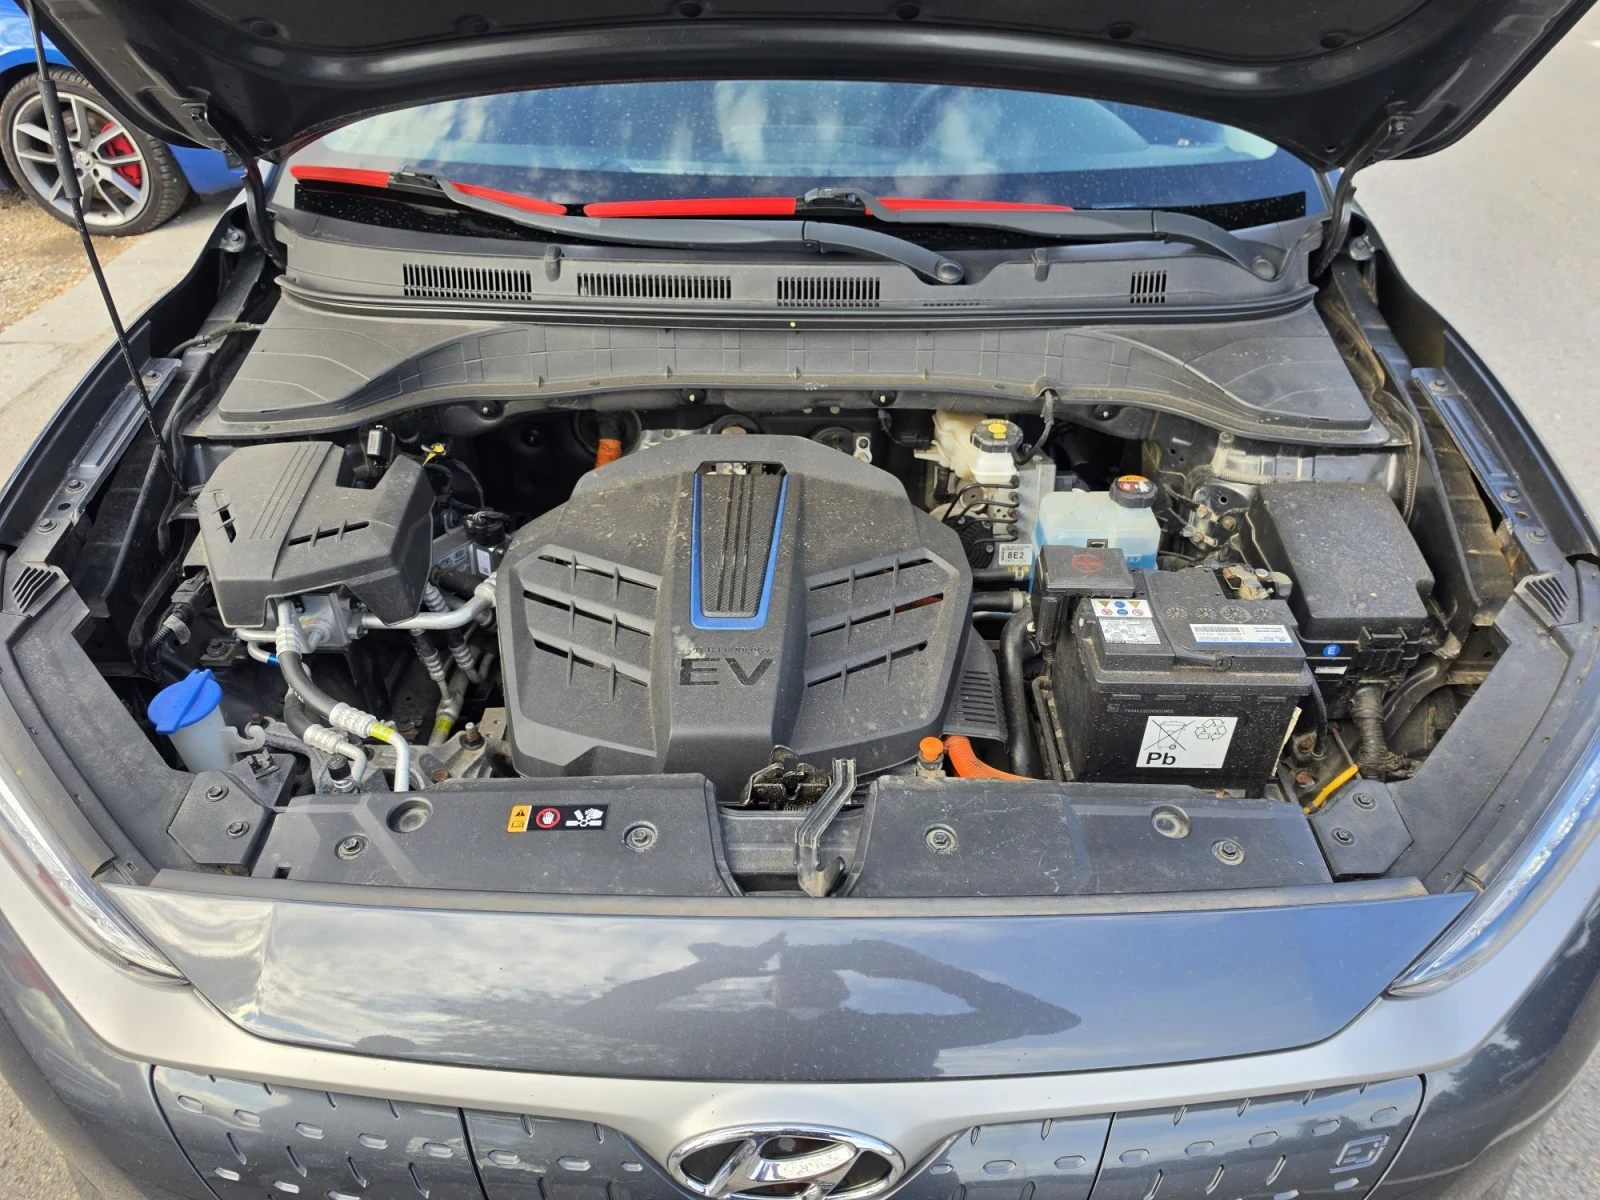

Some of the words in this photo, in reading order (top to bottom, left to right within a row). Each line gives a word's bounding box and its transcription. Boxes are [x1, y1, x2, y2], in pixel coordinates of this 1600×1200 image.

[1007, 551, 1024, 559] 8E2
[1327, 646, 1337, 655] E
[679, 657, 775, 685] EV
[1145, 751, 1176, 765] Pb
